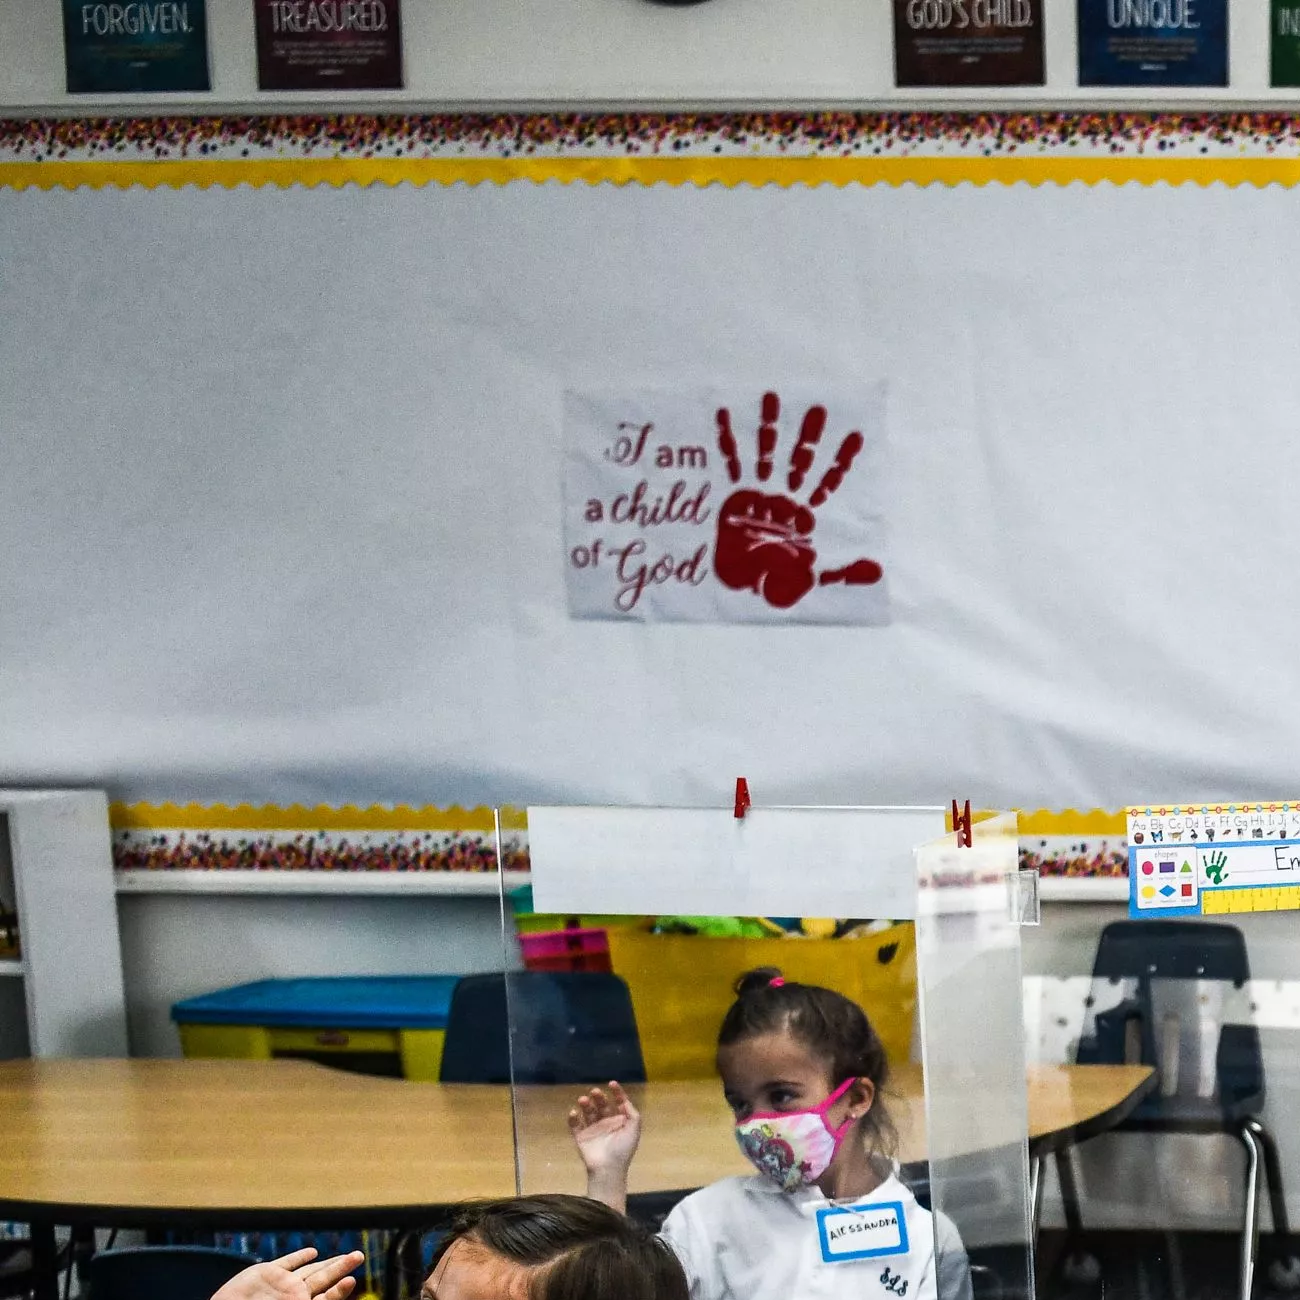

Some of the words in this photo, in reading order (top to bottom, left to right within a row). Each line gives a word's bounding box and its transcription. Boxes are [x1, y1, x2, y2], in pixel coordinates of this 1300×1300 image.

[81, 1, 194, 35] FORGIVEN.
[269, 0, 388, 33] TREASURED.
[906, 0, 969, 30] GOD'S
[654, 444, 708, 469] am
[584, 498, 604, 523] a
[610, 478, 712, 528] child
[570, 538, 603, 570] of
[608, 538, 709, 612] God
